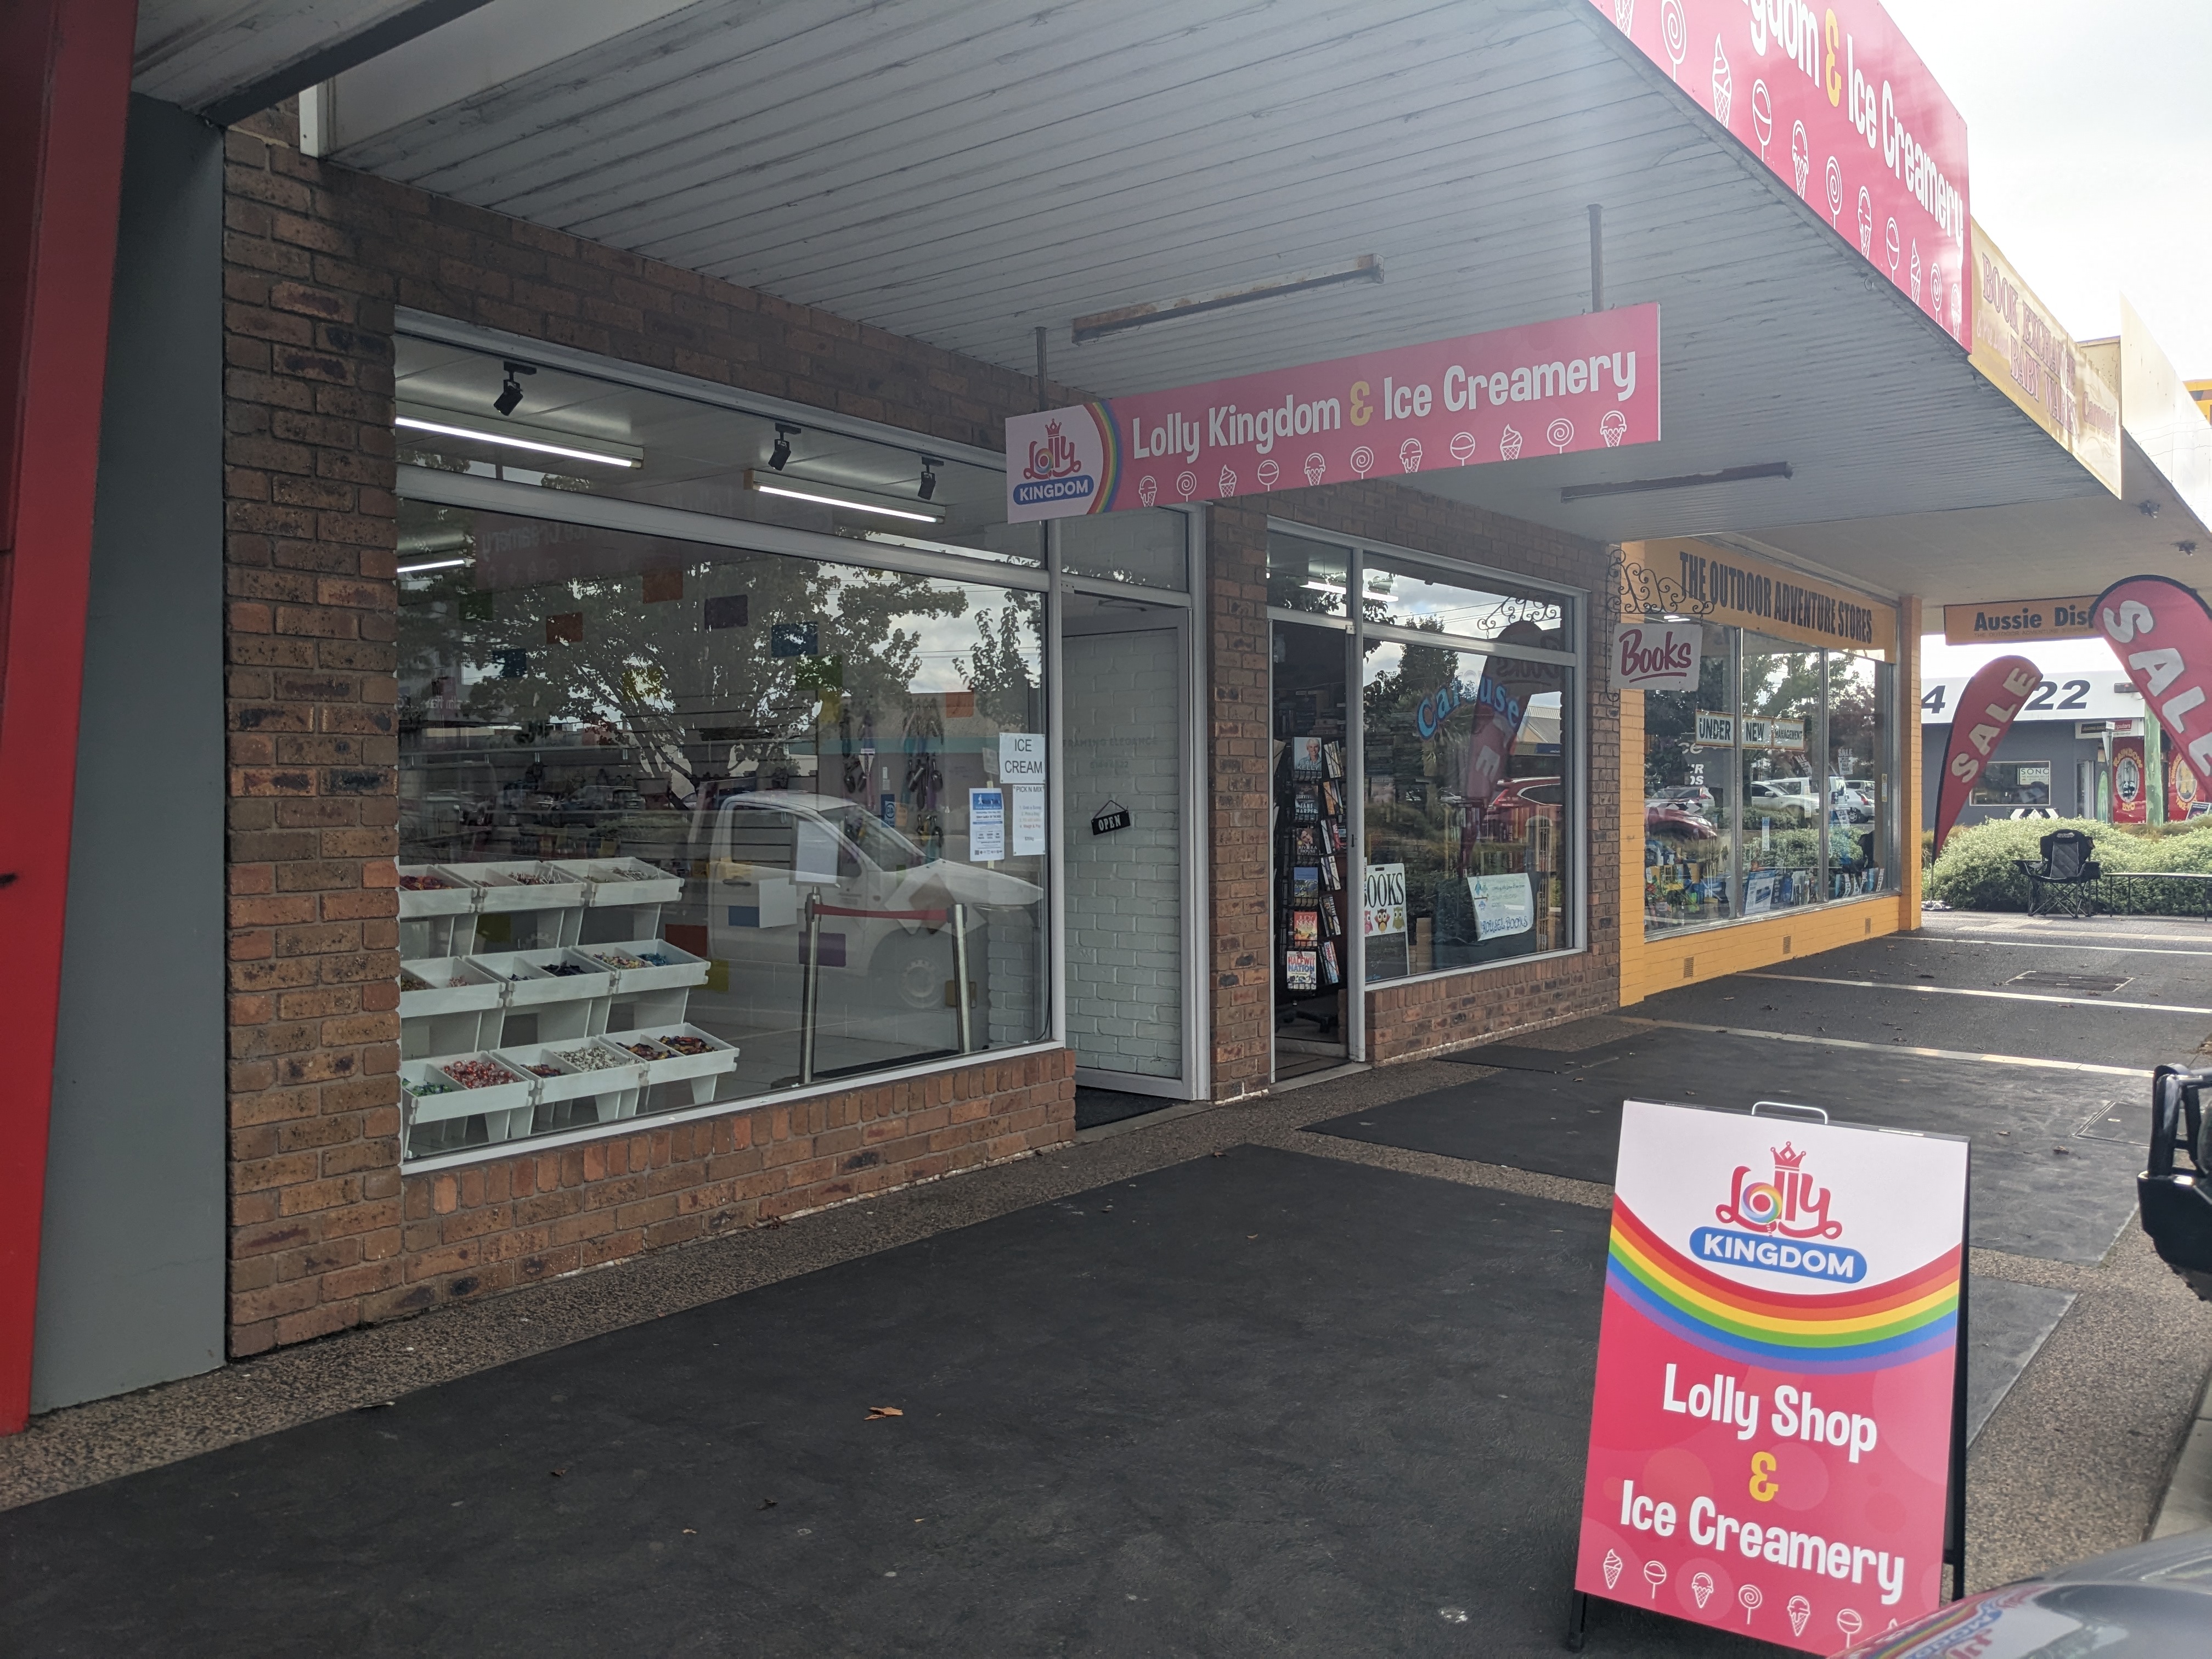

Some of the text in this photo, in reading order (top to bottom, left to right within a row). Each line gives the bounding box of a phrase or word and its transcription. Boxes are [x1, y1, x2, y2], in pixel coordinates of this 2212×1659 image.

[1825, 8, 1841, 107] &
[1847, 33, 1876, 149] Ice
[1883, 80, 1964, 268] Creamery
[1982, 252, 2019, 335] BOOK
[2010, 335, 2041, 403] BABY
[1133, 351, 1637, 464] Lolly Kingdom & Ice Creamery
[1023, 435, 1082, 480] Lolly
[1020, 479, 1088, 501] KINGDOM
[1680, 551, 1872, 644] THE OUTDOOR ADVENTURE STORES
[1974, 607, 2042, 631] Aussie
[1618, 629, 1692, 677] Books
[1014, 738, 1032, 752] ICE
[1699, 718, 1803, 742] UNDER NEW MANAGEMENT
[1951, 668, 2036, 783] SALE
[1005, 760, 1043, 774] CREAM
[1098, 815, 1121, 832] OPEN
[1288, 956, 1315, 966] HALFWIT
[1288, 964, 1315, 973] NATION
[1716, 1165, 1843, 1240] Lolly
[1703, 1233, 1854, 1278] KINGDOM
[1663, 1363, 1877, 1463] Lolly Shop
[1748, 1452, 1779, 1502] &
[1621, 1480, 1905, 1605] Ice Creamery
